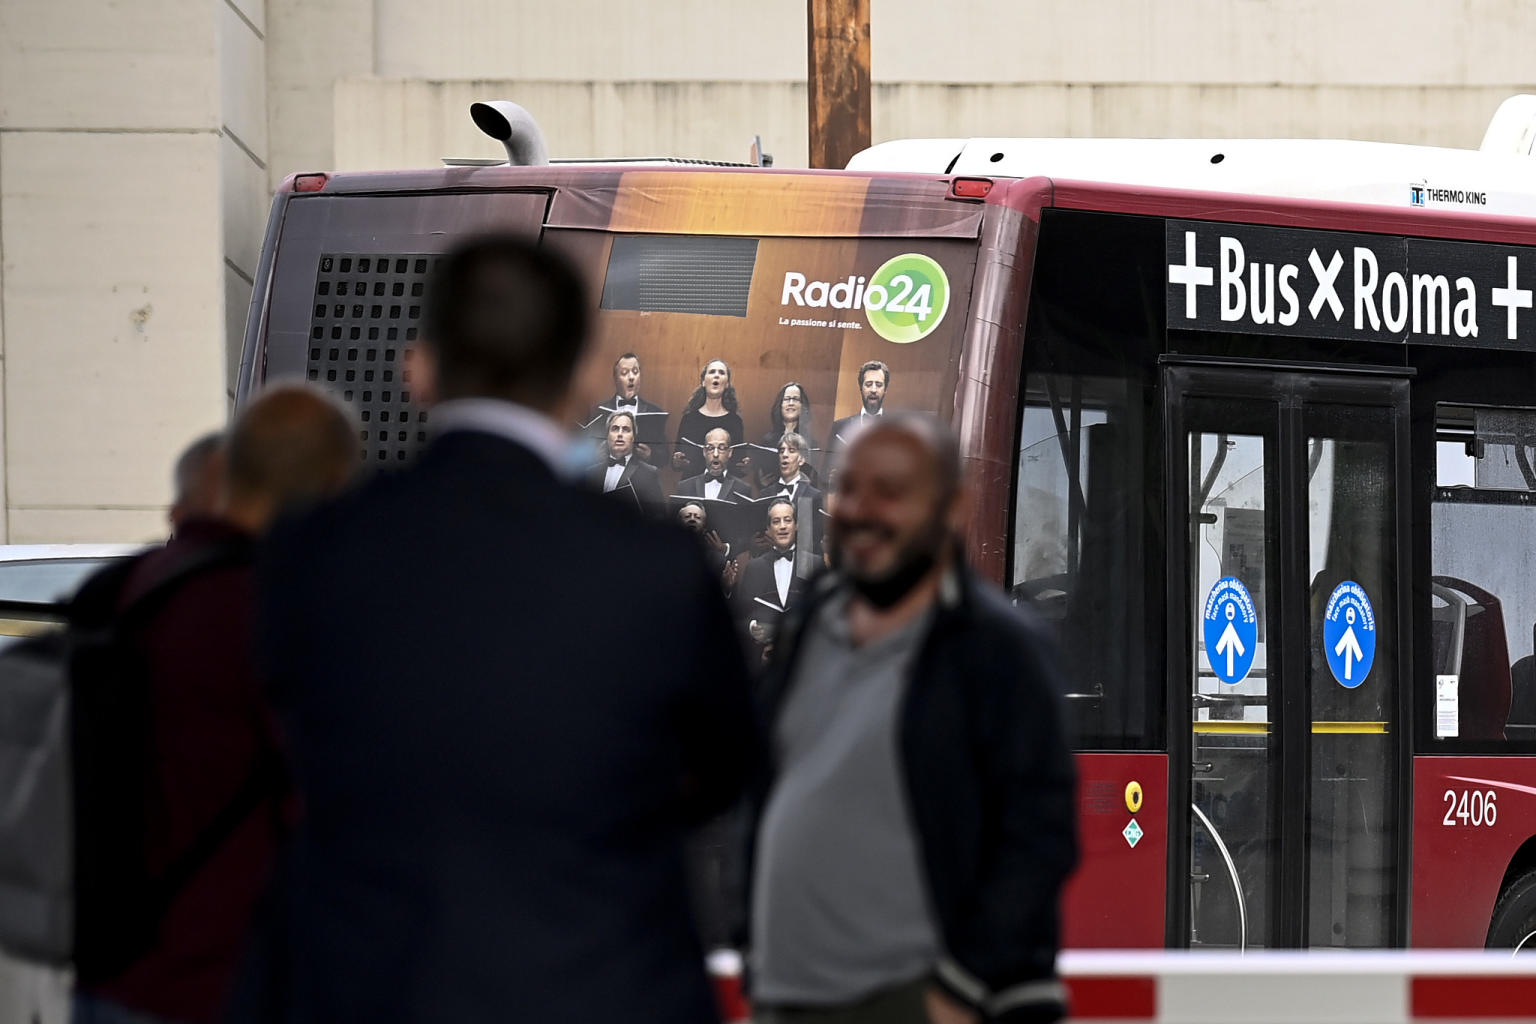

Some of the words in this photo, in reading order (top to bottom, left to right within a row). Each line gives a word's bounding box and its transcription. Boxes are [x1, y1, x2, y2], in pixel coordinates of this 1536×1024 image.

[1426, 188, 1465, 203] THERMO
[1465, 191, 1487, 205] KING
[781, 272, 932, 320] Radio24
[779, 317, 789, 325] La
[791, 319, 827, 327] passione
[828, 320, 836, 328] si
[837, 321, 863, 329] sente.
[1442, 790, 1497, 826] 2406
